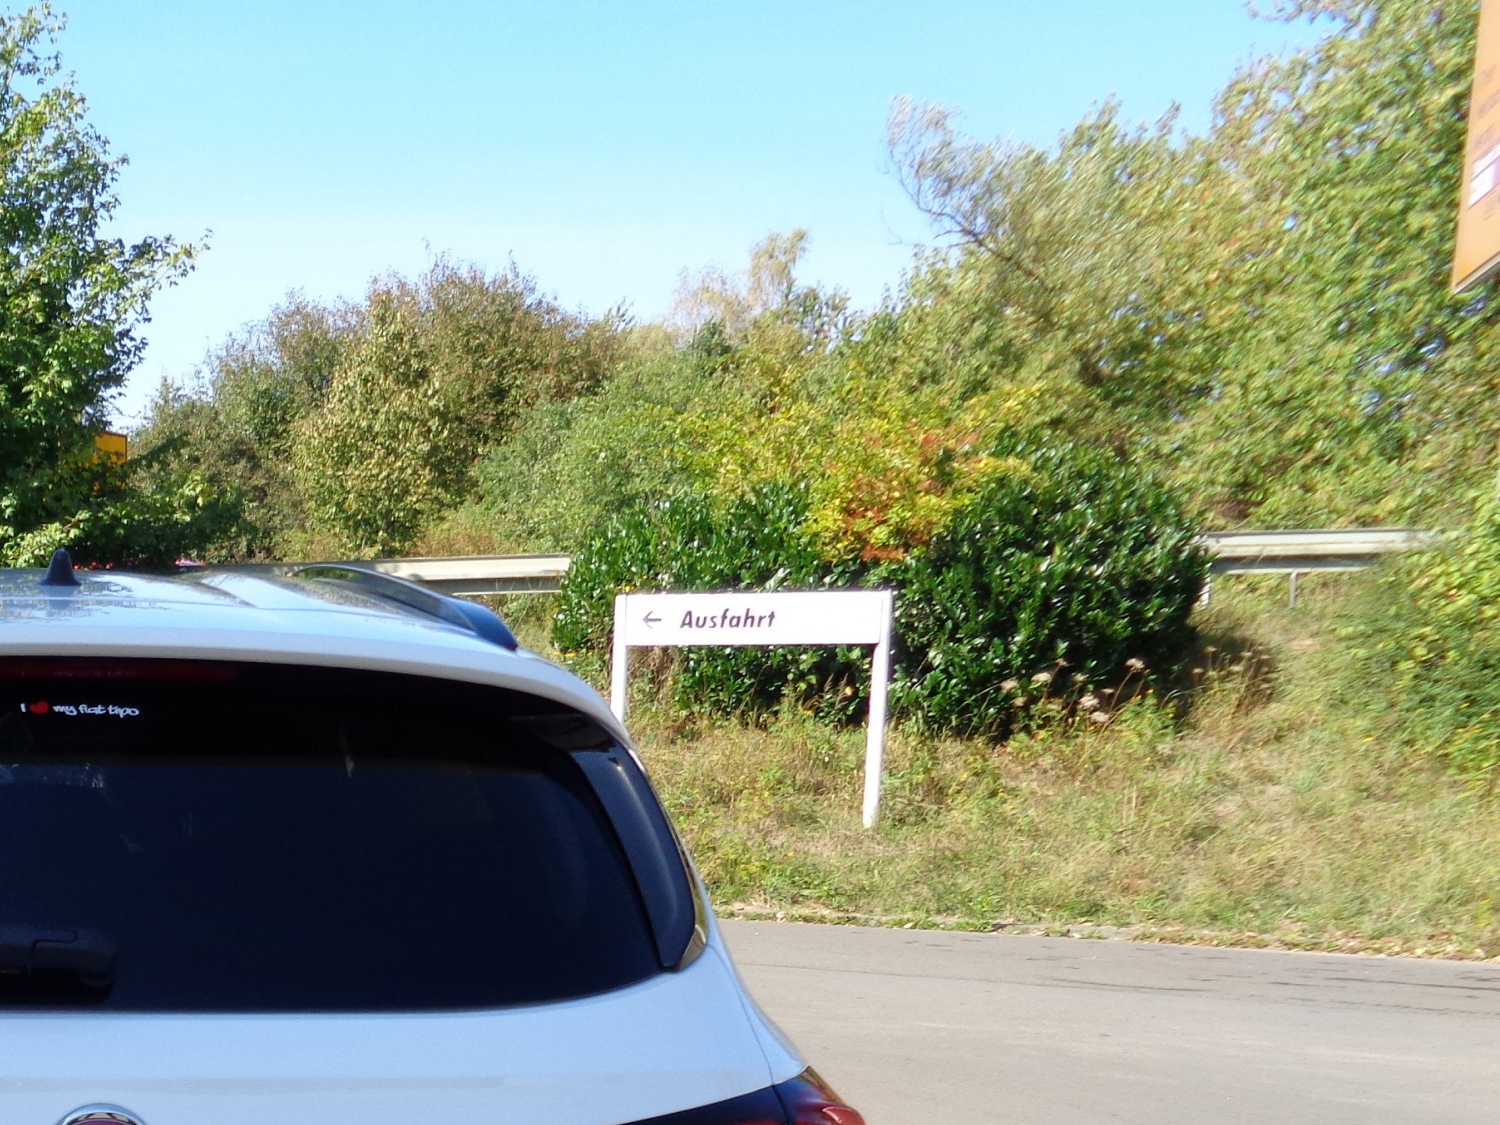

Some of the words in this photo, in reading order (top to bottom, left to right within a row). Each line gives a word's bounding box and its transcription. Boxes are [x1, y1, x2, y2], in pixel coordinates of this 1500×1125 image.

[680, 608, 776, 629] Ausfahrt
[53, 704, 77, 716] my
[78, 703, 107, 715] fiat
[107, 704, 140, 718] tipo
